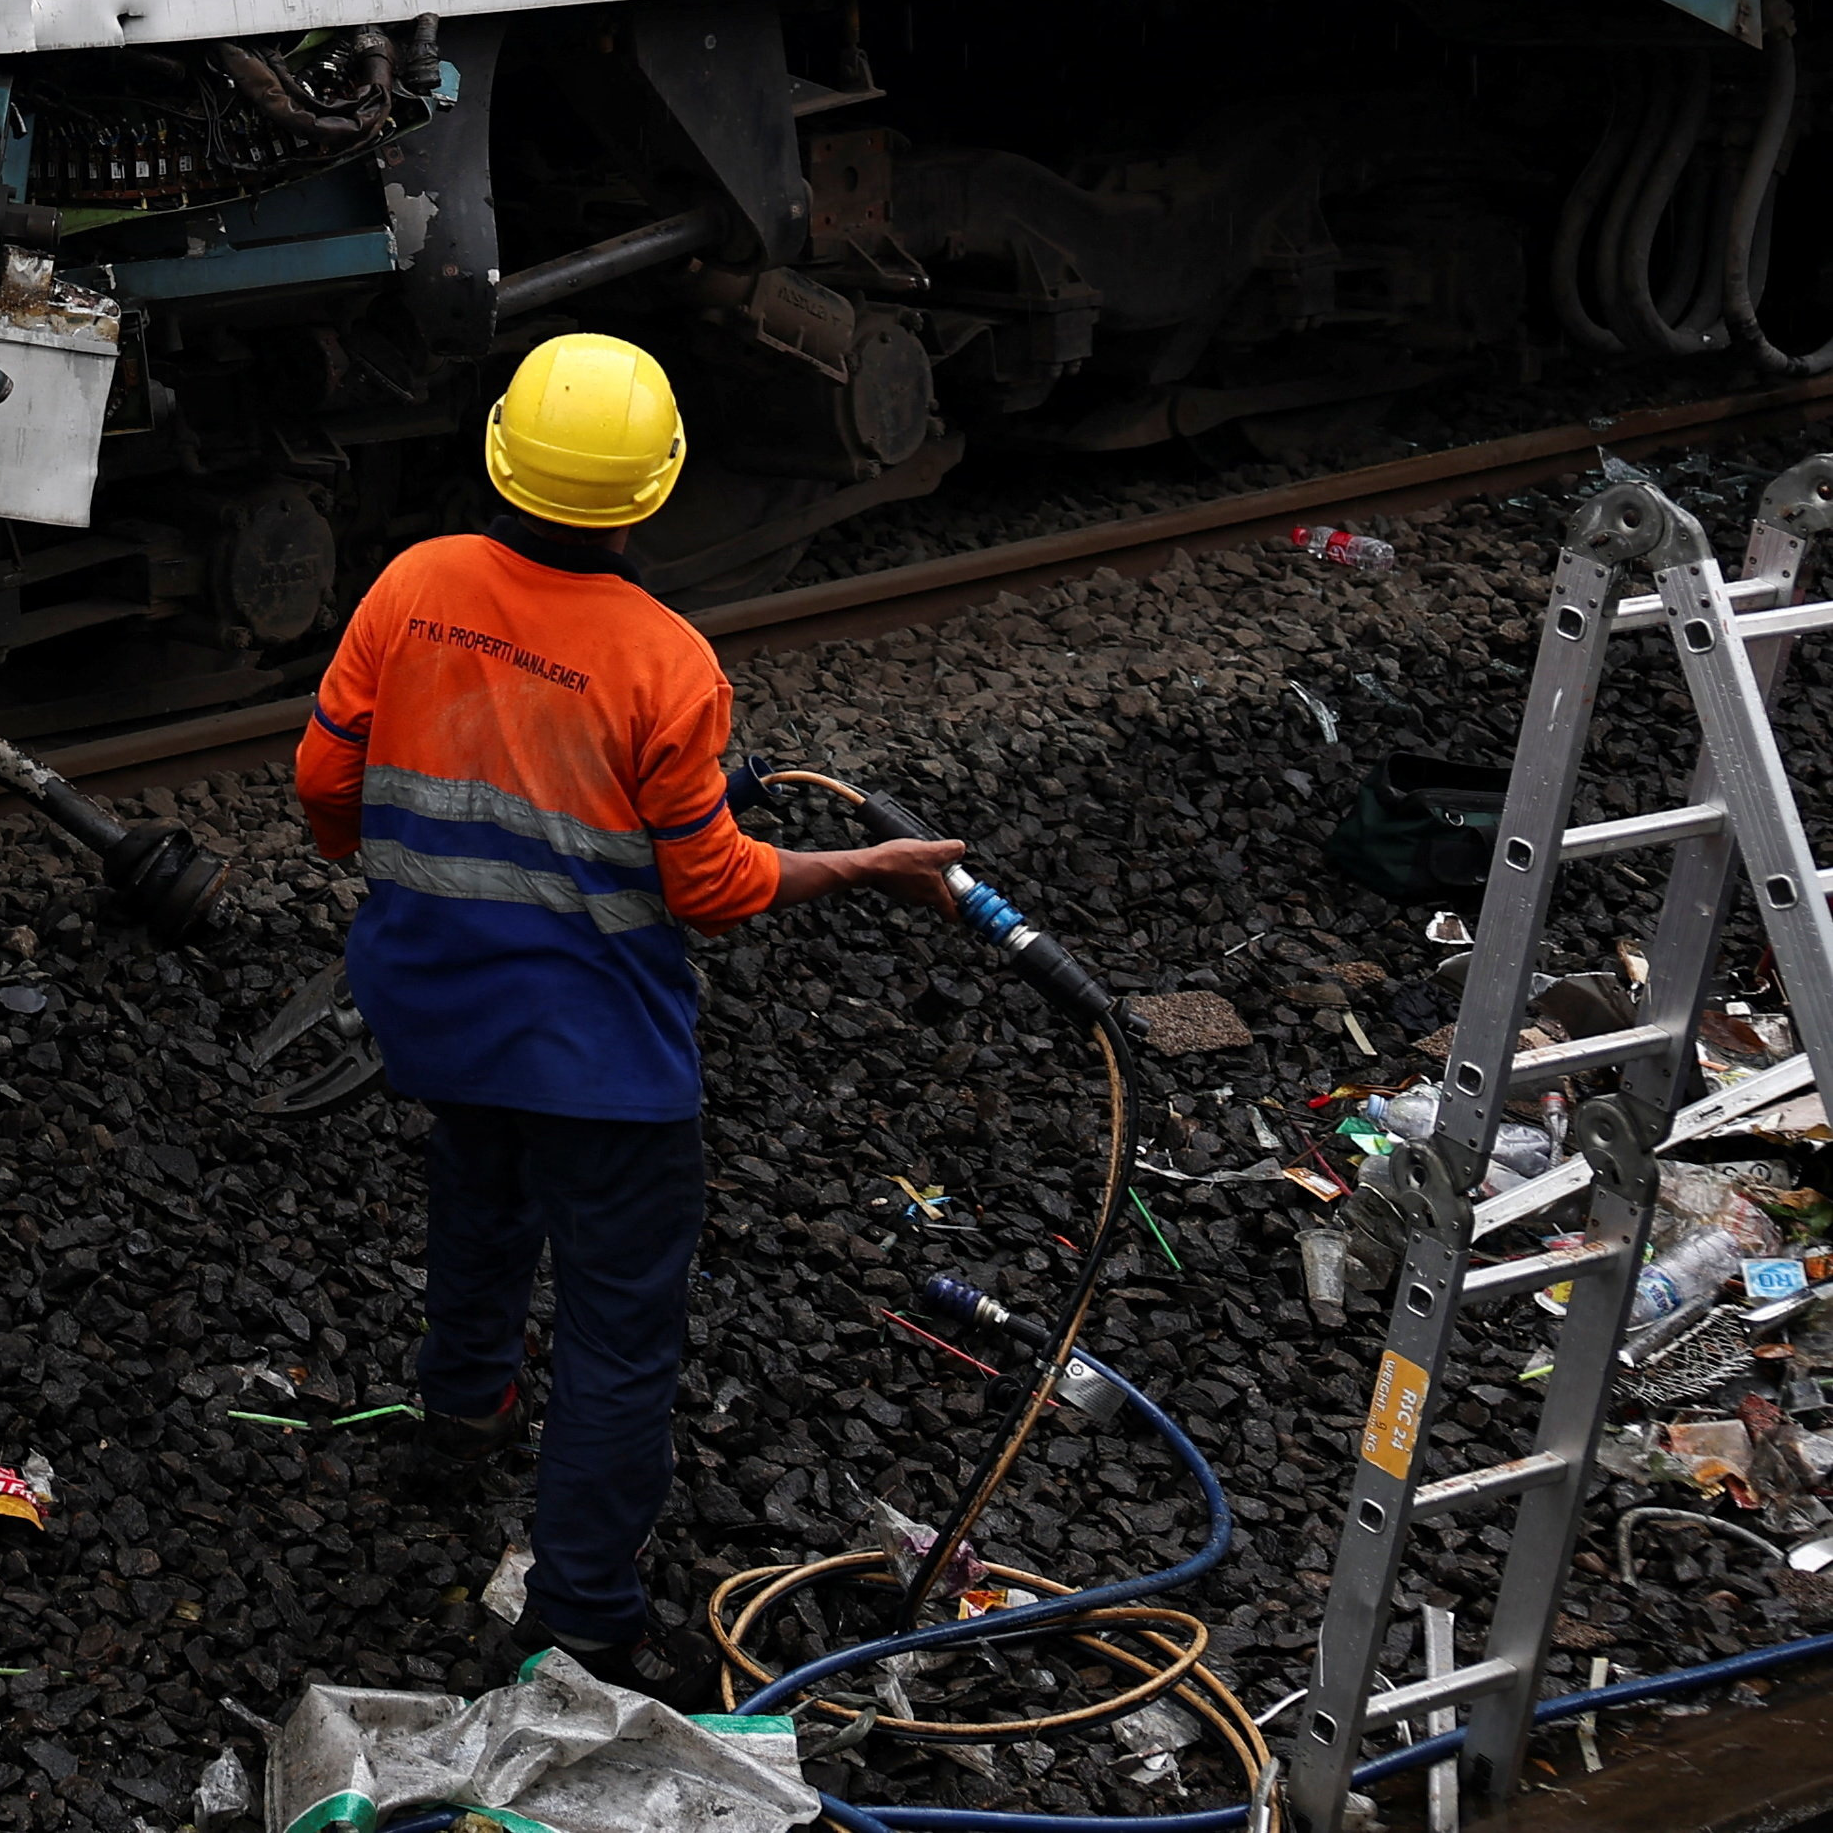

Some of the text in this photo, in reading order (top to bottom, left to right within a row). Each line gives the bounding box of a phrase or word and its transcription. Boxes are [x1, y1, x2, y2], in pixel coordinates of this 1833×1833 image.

[408, 618, 427, 639] PT
[448, 626, 514, 663] PROPERTI
[512, 647, 590, 695] MANAJEMEN
[1365, 1432, 1378, 1454] KG
[1390, 1387, 1418, 1452] RSC 24
